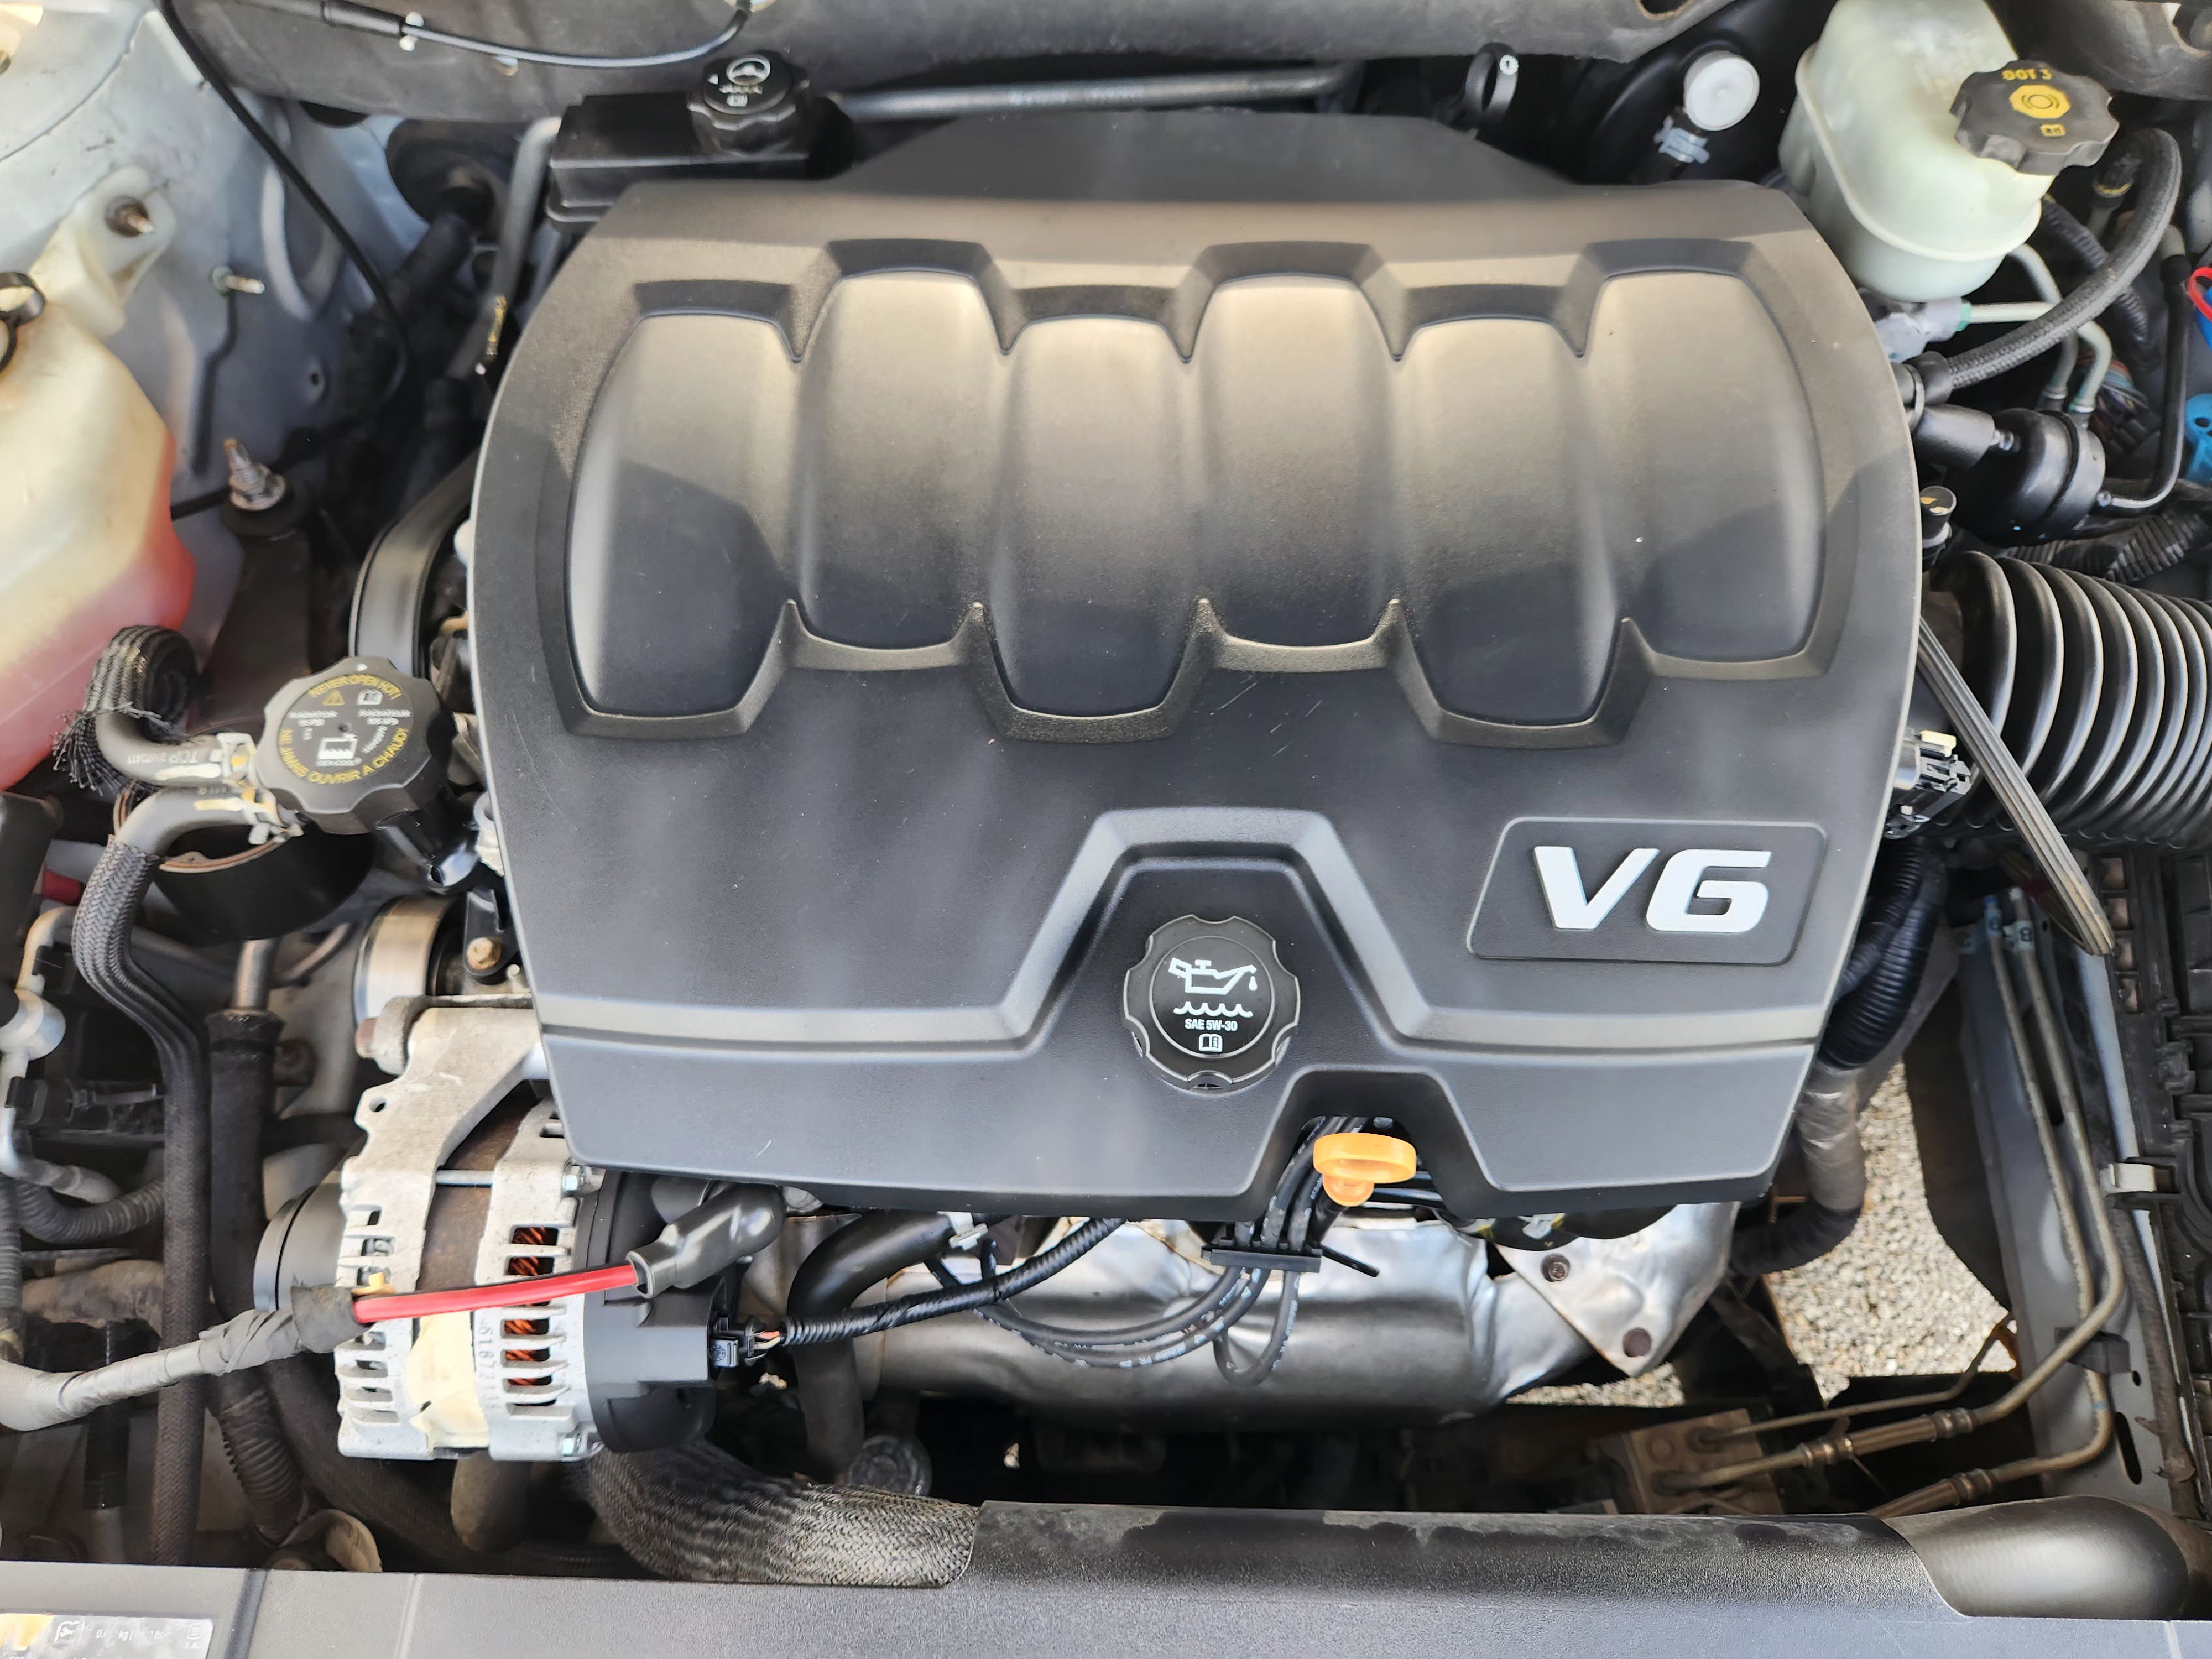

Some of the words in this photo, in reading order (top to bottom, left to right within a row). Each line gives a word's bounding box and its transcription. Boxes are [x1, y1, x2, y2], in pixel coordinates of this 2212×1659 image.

[2002, 68, 2037, 81] DOT
[1533, 846, 1772, 933] V6
[1185, 1018, 1205, 1030] SAE
[1206, 1020, 1238, 1032] 5W-30
